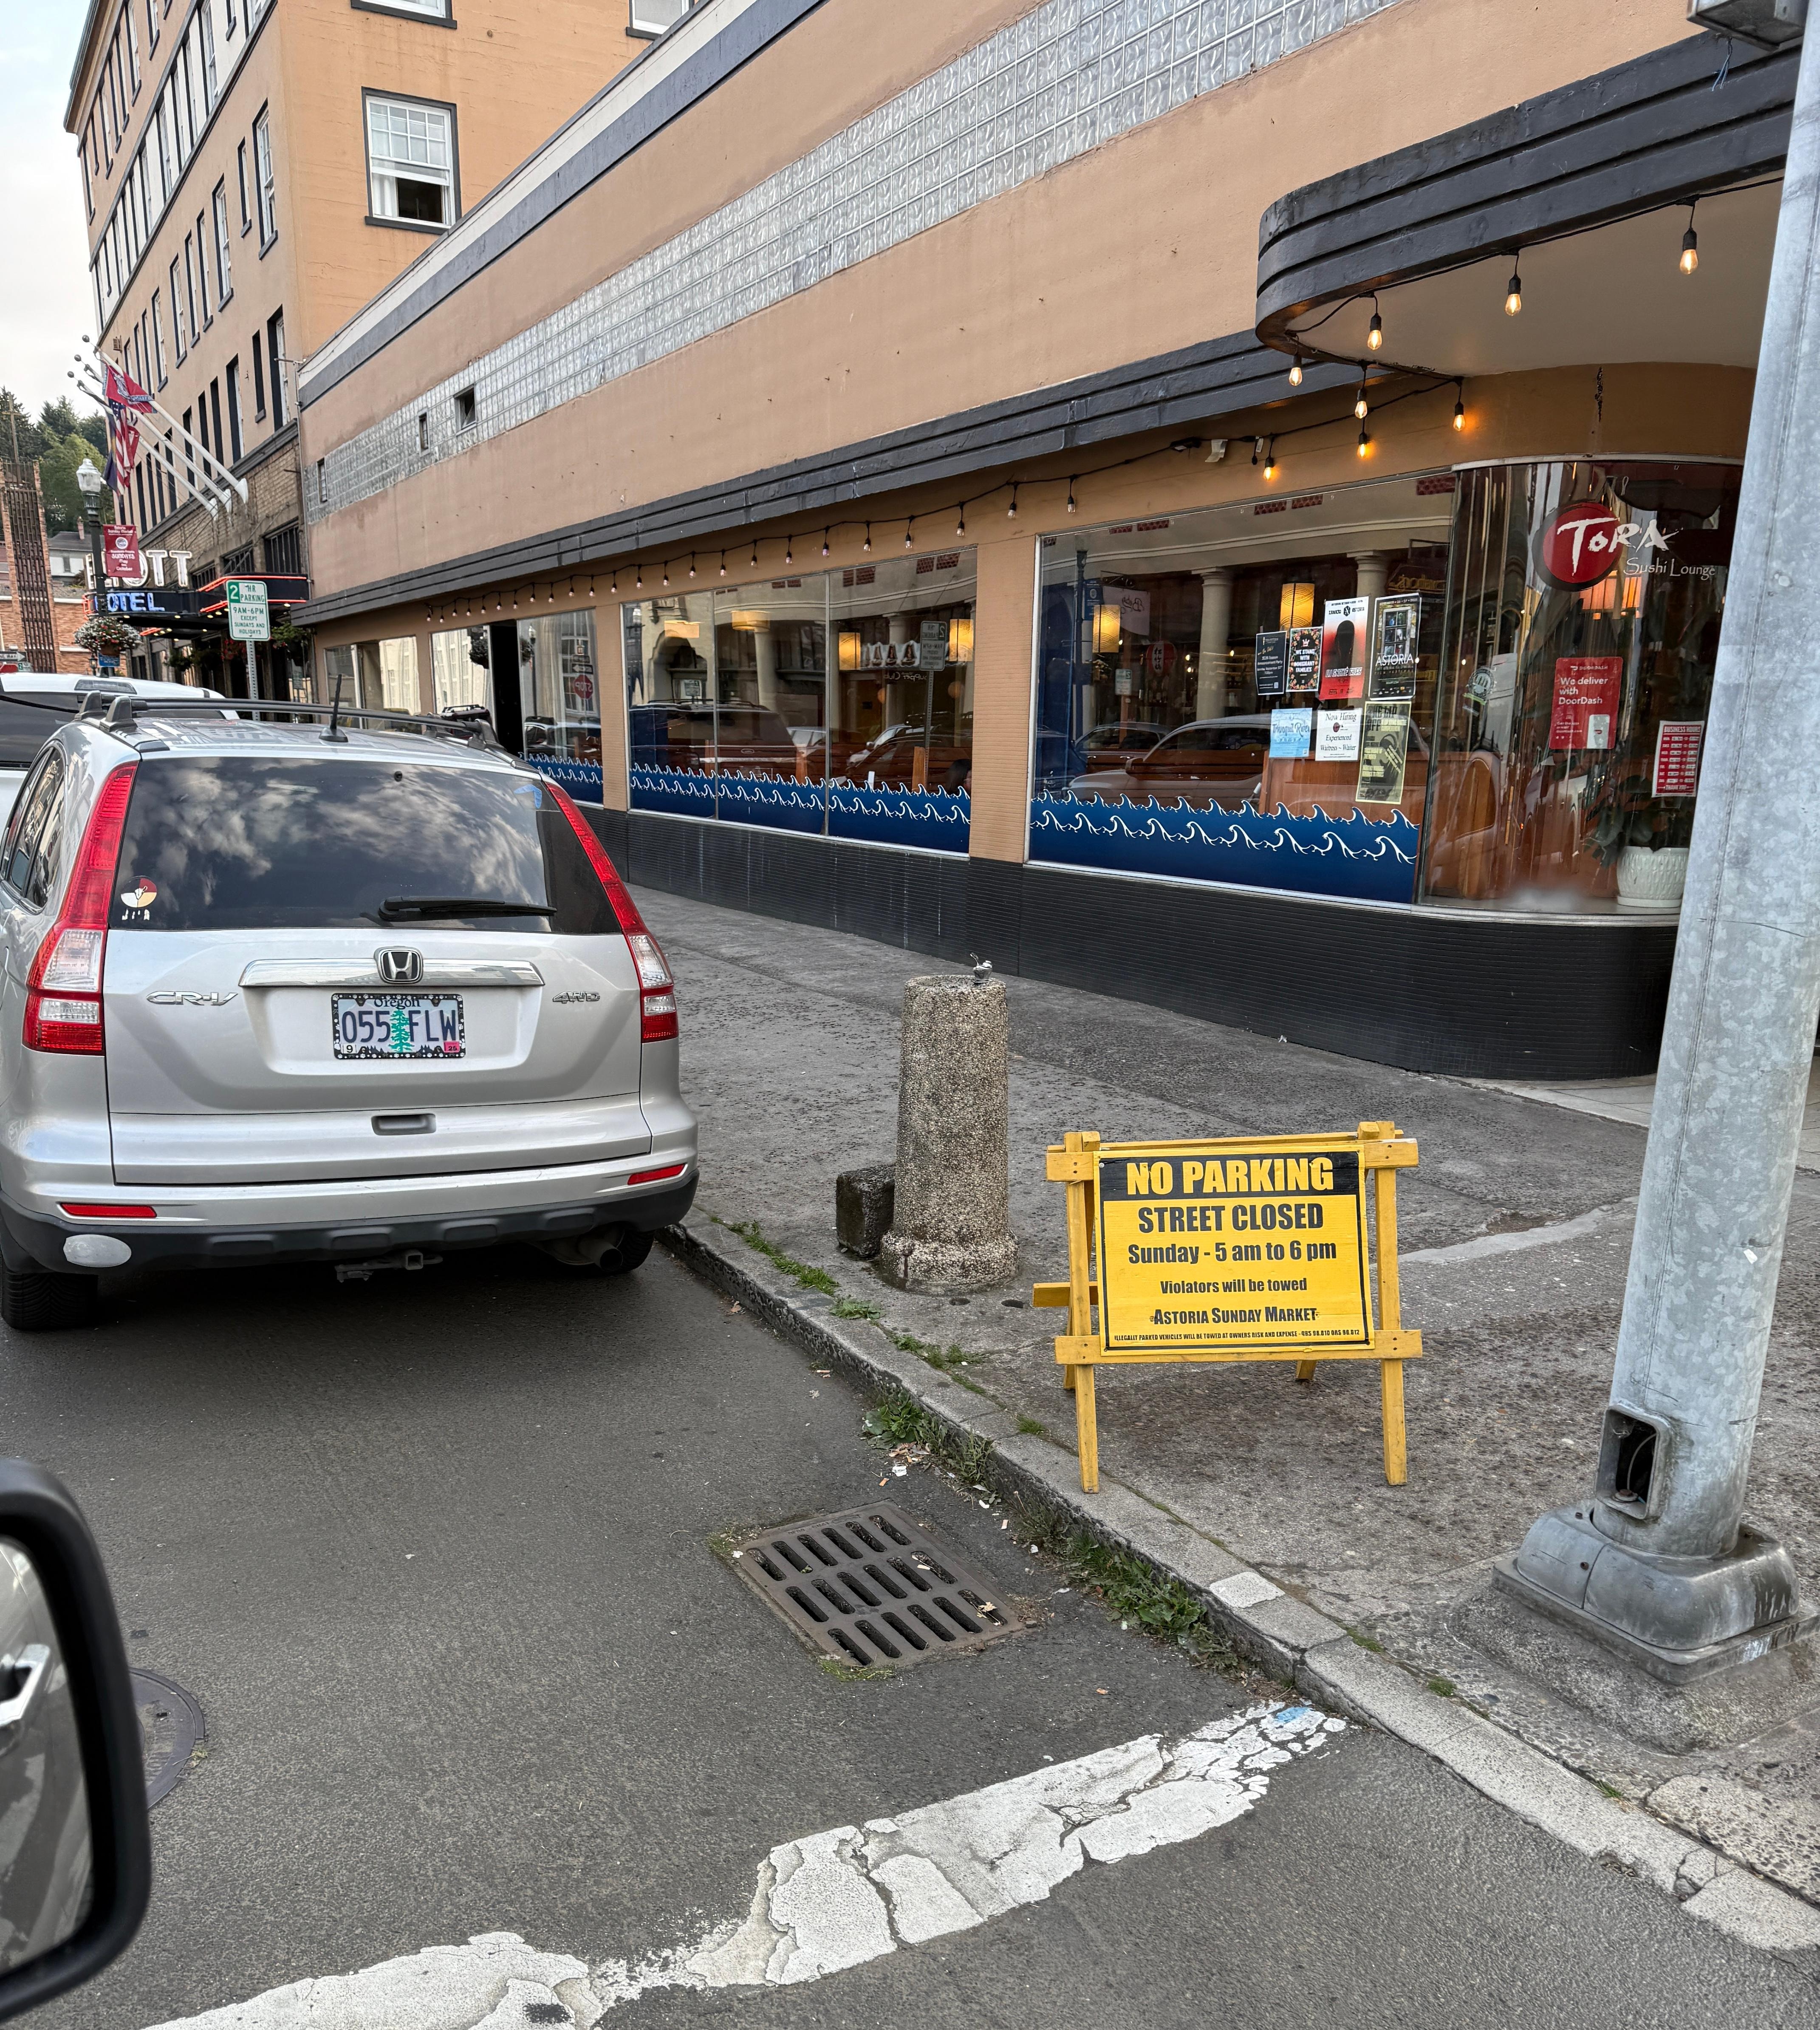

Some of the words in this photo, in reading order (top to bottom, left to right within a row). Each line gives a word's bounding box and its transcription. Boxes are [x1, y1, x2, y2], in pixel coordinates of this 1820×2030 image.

[1623, 558, 1667, 575] Sushi
[1670, 558, 1716, 580] Lounge
[230, 585, 239, 599] 2
[1375, 653, 1414, 667] ASTORIA
[1577, 677, 1608, 685] deliver
[1559, 687, 1578, 695] with
[1339, 713, 1357, 722] Hiring
[146, 991, 239, 1006] CR-V
[374, 999, 421, 1010] Oregon
[552, 991, 601, 1004] 4WD
[342, 1011, 391, 1043] 055
[408, 1009, 456, 1042] FLW
[346, 1045, 353, 1053] 9
[1127, 1161, 1173, 1195] NO
[1183, 1157, 1334, 1194] PARKING
[1139, 1205, 1226, 1234] STREET
[1232, 1203, 1324, 1231] CLOSED
[1128, 1243, 1199, 1264] Sunday
[1215, 1242, 1227, 1262] 5
[1232, 1245, 1261, 1261] am
[1266, 1242, 1285, 1260] to
[1290, 1240, 1302, 1260] 6
[1307, 1243, 1337, 1261] pm
[1160, 1280, 1219, 1294] Violators
[1222, 1279, 1246, 1292] will
[1249, 1279, 1265, 1292] be
[1267, 1277, 1307, 1291] towed
